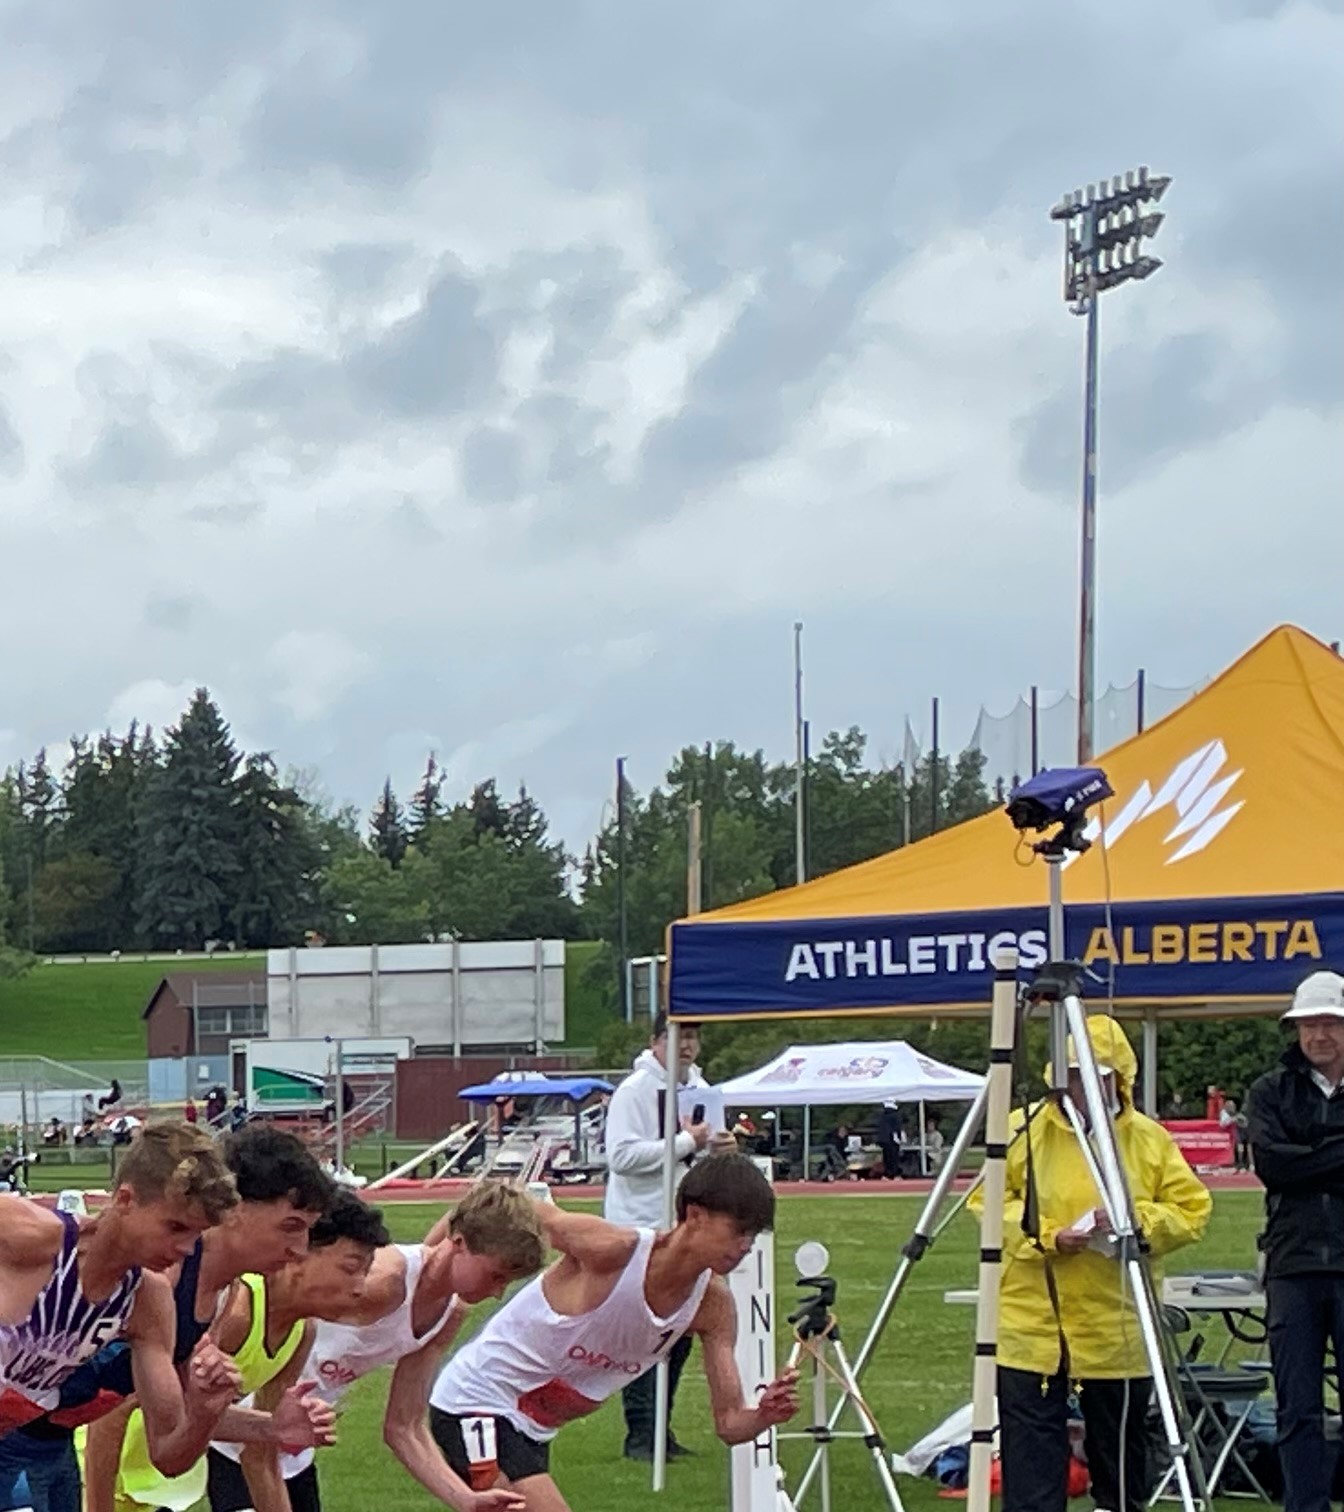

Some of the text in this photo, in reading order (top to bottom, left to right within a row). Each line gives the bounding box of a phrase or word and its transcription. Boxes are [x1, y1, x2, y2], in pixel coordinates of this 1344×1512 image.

[784, 919, 1323, 983] ATHLETICS ALBERTA
[651, 1328, 675, 1355] 1
[470, 1419, 487, 1459] 1
